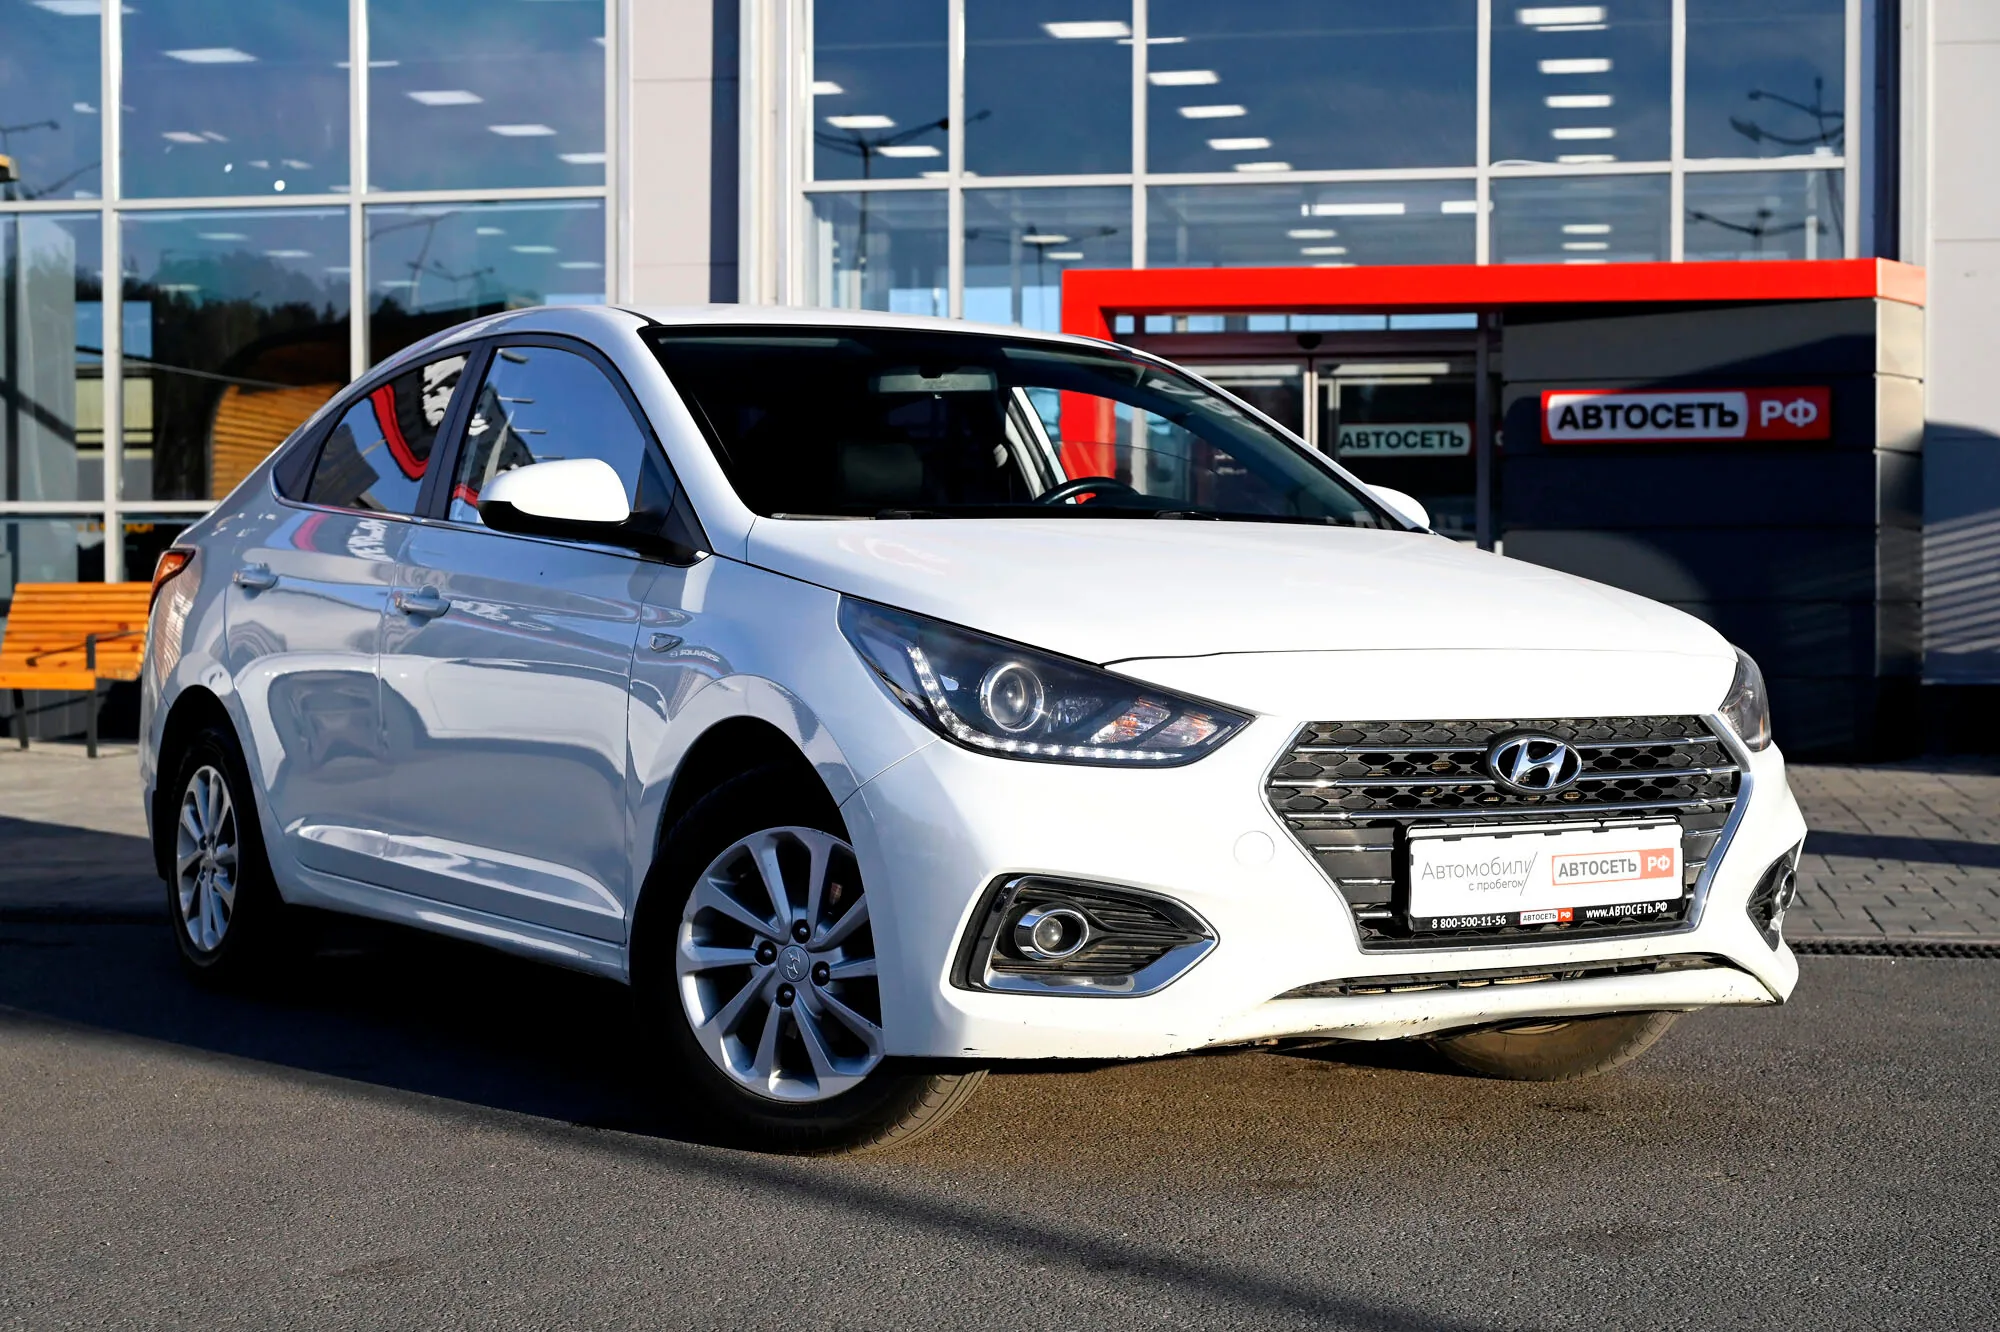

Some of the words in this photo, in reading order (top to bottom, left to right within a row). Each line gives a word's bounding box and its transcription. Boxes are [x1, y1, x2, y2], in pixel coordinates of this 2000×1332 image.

[1557, 402, 1739, 431] АВТОСЕТЬ
[1760, 397, 1818, 427] РФ
[1339, 430, 1464, 449] АВТОСЕТЬ
[1558, 858, 1637, 878] АВТОСЕТЬ
[1647, 855, 1671, 872] РФ
[1468, 882, 1476, 891] с
[1522, 912, 1557, 922] АВТОСЕТЬ
[1560, 911, 1571, 919] РФ
[1586, 902, 1668, 918] www.АВТОСЕТЬ.РФ
[1431, 918, 1438, 929] 8
[1440, 915, 1507, 928] 800-500-11-56
